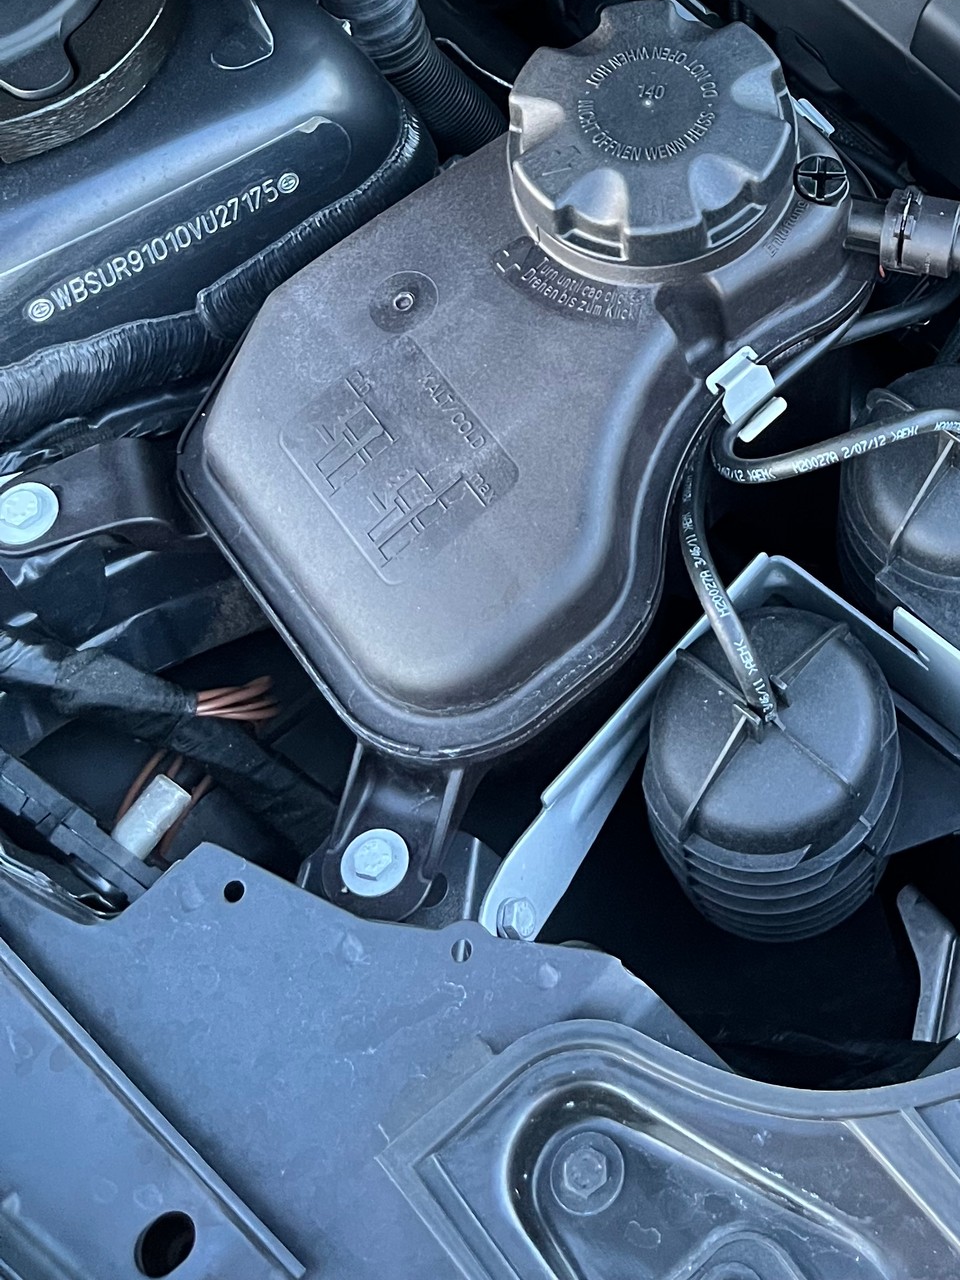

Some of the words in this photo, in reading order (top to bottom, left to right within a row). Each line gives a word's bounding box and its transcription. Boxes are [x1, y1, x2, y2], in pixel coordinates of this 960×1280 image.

[607, 46, 649, 70] WHEN
[651, 46, 687, 65] OPEN
[683, 59, 712, 82] NOT
[585, 64, 612, 89] HOT
[700, 81, 718, 98] DO
[577, 99, 601, 133] NICHT
[644, 137, 687, 161] WENN
[683, 111, 715, 144] HEISS
[51, 178, 279, 311] WBSUR91010VU27175
[520, 268, 559, 300] Drehen
[557, 289, 578, 307] bis
[576, 300, 603, 316] zum
[536, 256, 559, 277] Turn
[557, 275, 584, 293] until
[581, 285, 603, 304] cap
[791, 453, 840, 475] M20027A
[841, 434, 887, 459] 2/07/12
[700, 570, 731, 618] M20027A
